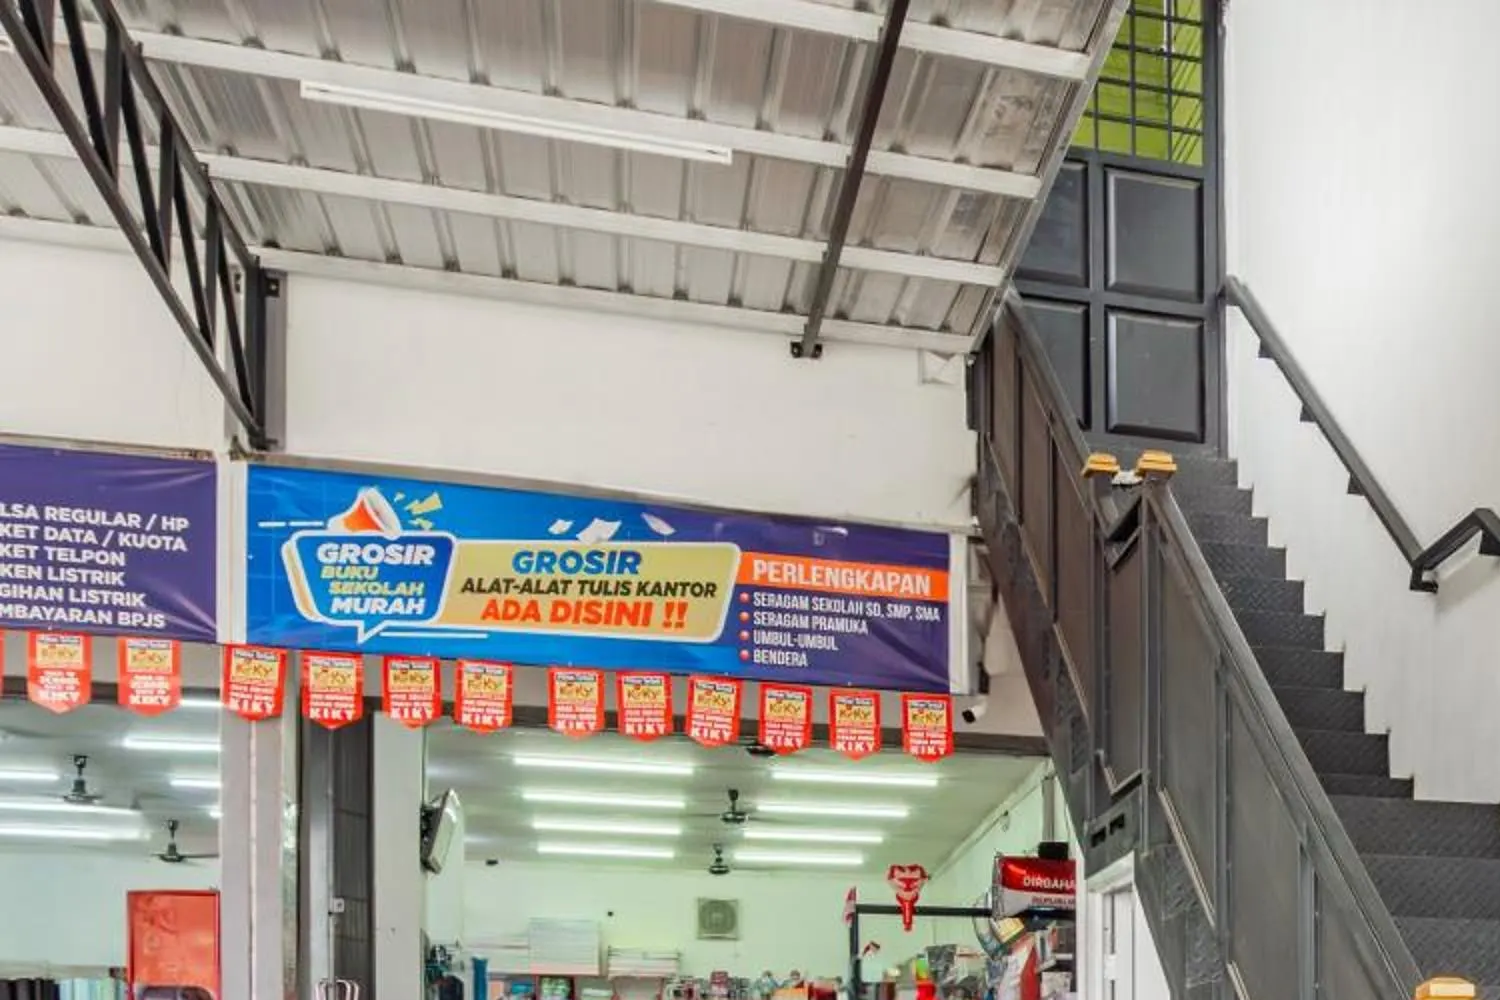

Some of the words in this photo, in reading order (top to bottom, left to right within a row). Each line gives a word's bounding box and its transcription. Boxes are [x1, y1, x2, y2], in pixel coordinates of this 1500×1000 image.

[44, 507, 141, 529] REGULAR
[145, 513, 157, 532] /
[161, 515, 190, 533] HP
[44, 526, 99, 545] DATA
[102, 529, 115, 548] /
[118, 532, 188, 552] KUOTA
[44, 546, 126, 566] TELPON
[316, 542, 436, 565] GROSIR
[511, 550, 643, 575] GROSIR
[48, 567, 126, 587] LISTRIK
[320, 565, 379, 580] BUKU
[752, 559, 931, 596] PERLENGKAPAN
[69, 588, 147, 608] LISTRIK
[329, 581, 425, 596] SEKOLAH
[461, 577, 572, 595] ALAT-ALAT
[577, 579, 632, 596] TULIS
[636, 581, 717, 598] KANTOR
[330, 597, 426, 615] MURAH
[480, 599, 542, 623] ADA
[549, 600, 656, 627] DISINI
[753, 592, 809, 611] SERAGAM
[812, 596, 863, 616] SEKOLAH
[915, 605, 940, 622] SMA
[117, 611, 166, 628] BPJS
[753, 611, 809, 630] SERAGAM
[812, 615, 869, 635] PRAMUKA
[753, 630, 839, 651] UMBUL-UMBUL
[753, 649, 808, 667] BENDERA
